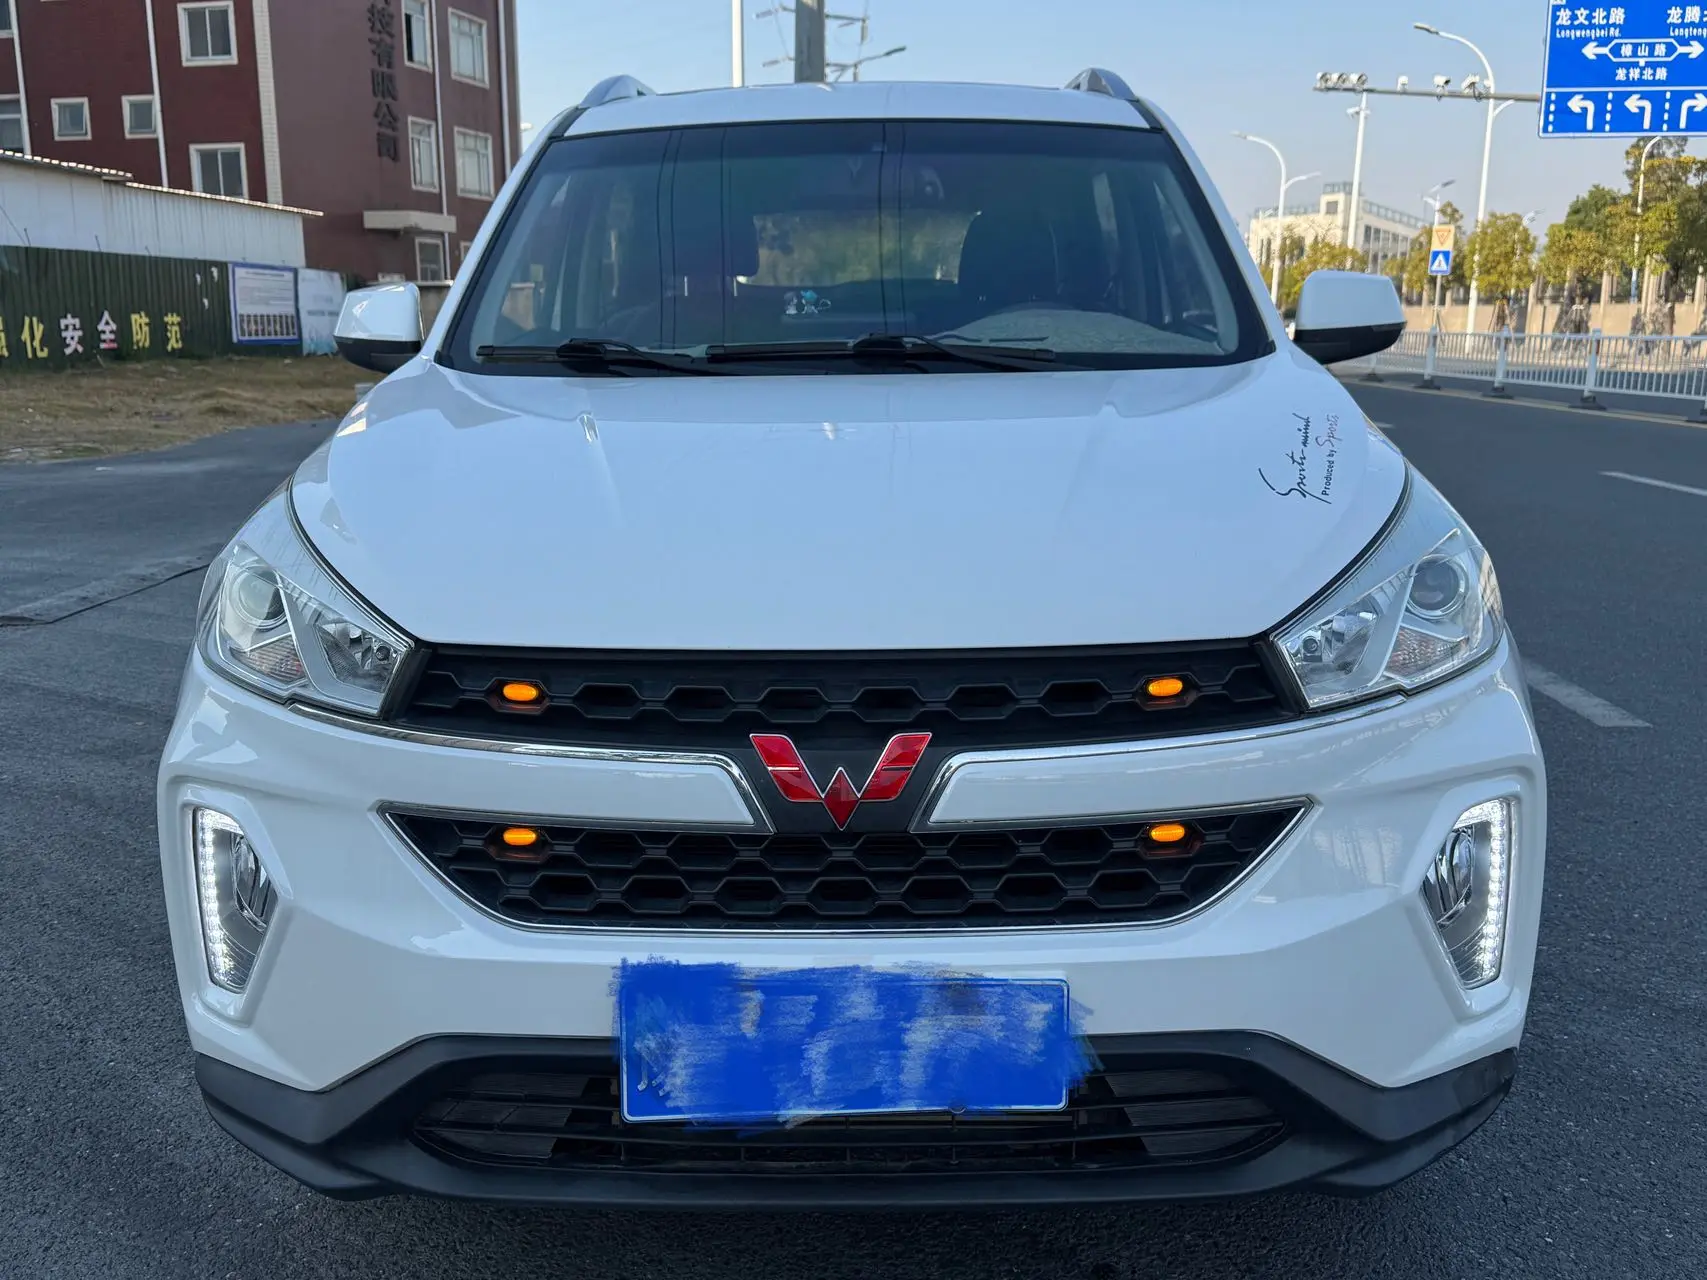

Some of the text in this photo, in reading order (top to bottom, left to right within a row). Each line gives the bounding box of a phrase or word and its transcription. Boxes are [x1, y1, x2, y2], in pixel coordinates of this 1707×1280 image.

[1555, 7, 1626, 26] 龙文北路
[1615, 67, 1668, 81] 龙祥北路
[1325, 449, 1337, 458] by
[1321, 460, 1335, 496] Produced
